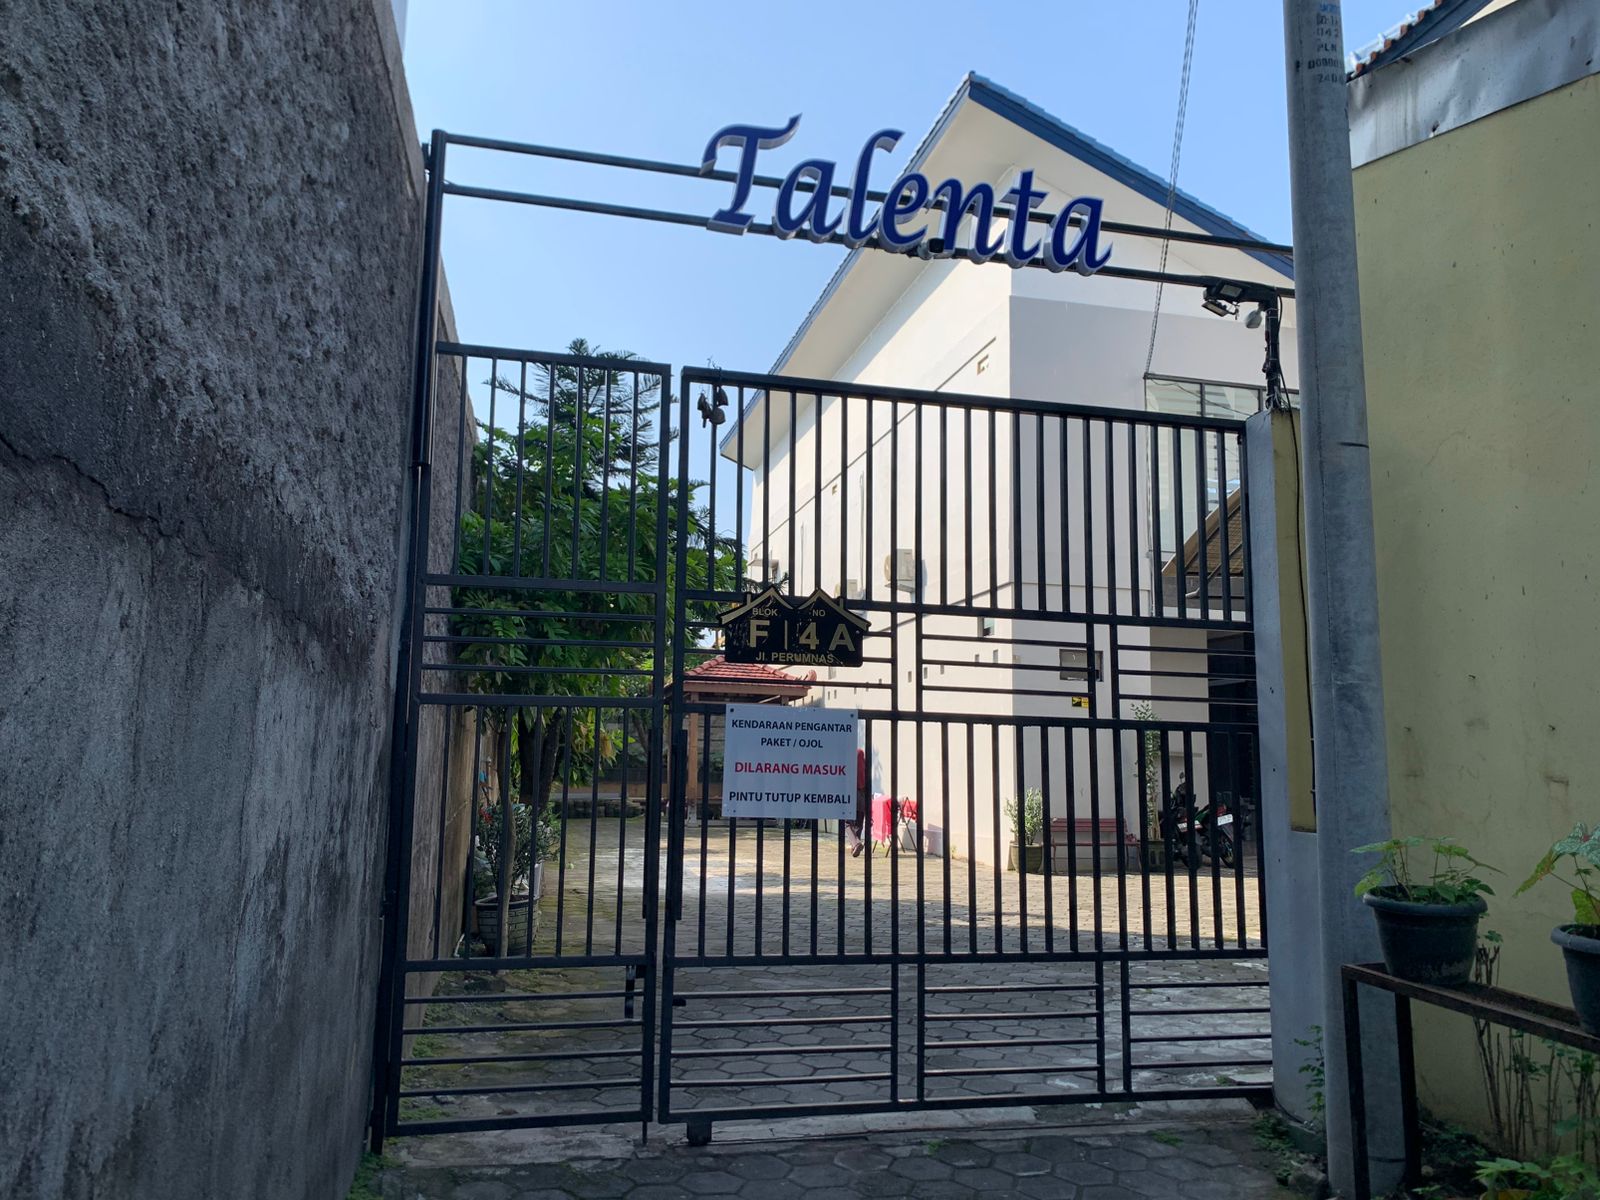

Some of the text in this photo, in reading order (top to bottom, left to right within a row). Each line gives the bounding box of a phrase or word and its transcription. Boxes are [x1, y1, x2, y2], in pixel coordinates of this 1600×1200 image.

[700, 112, 1113, 276] Talenta
[752, 607, 826, 617] BLOK NO
[749, 619, 771, 648] F
[771, 652, 834, 664] PERUMNAS
[731, 719, 852, 733] KENDARAAN PENGANTAR
[760, 737, 791, 747] PAKET
[798, 738, 824, 749] OJOL
[734, 761, 847, 776] DILARANG MASUK
[729, 791, 851, 805] PINTU TUTUP KEMBALI
